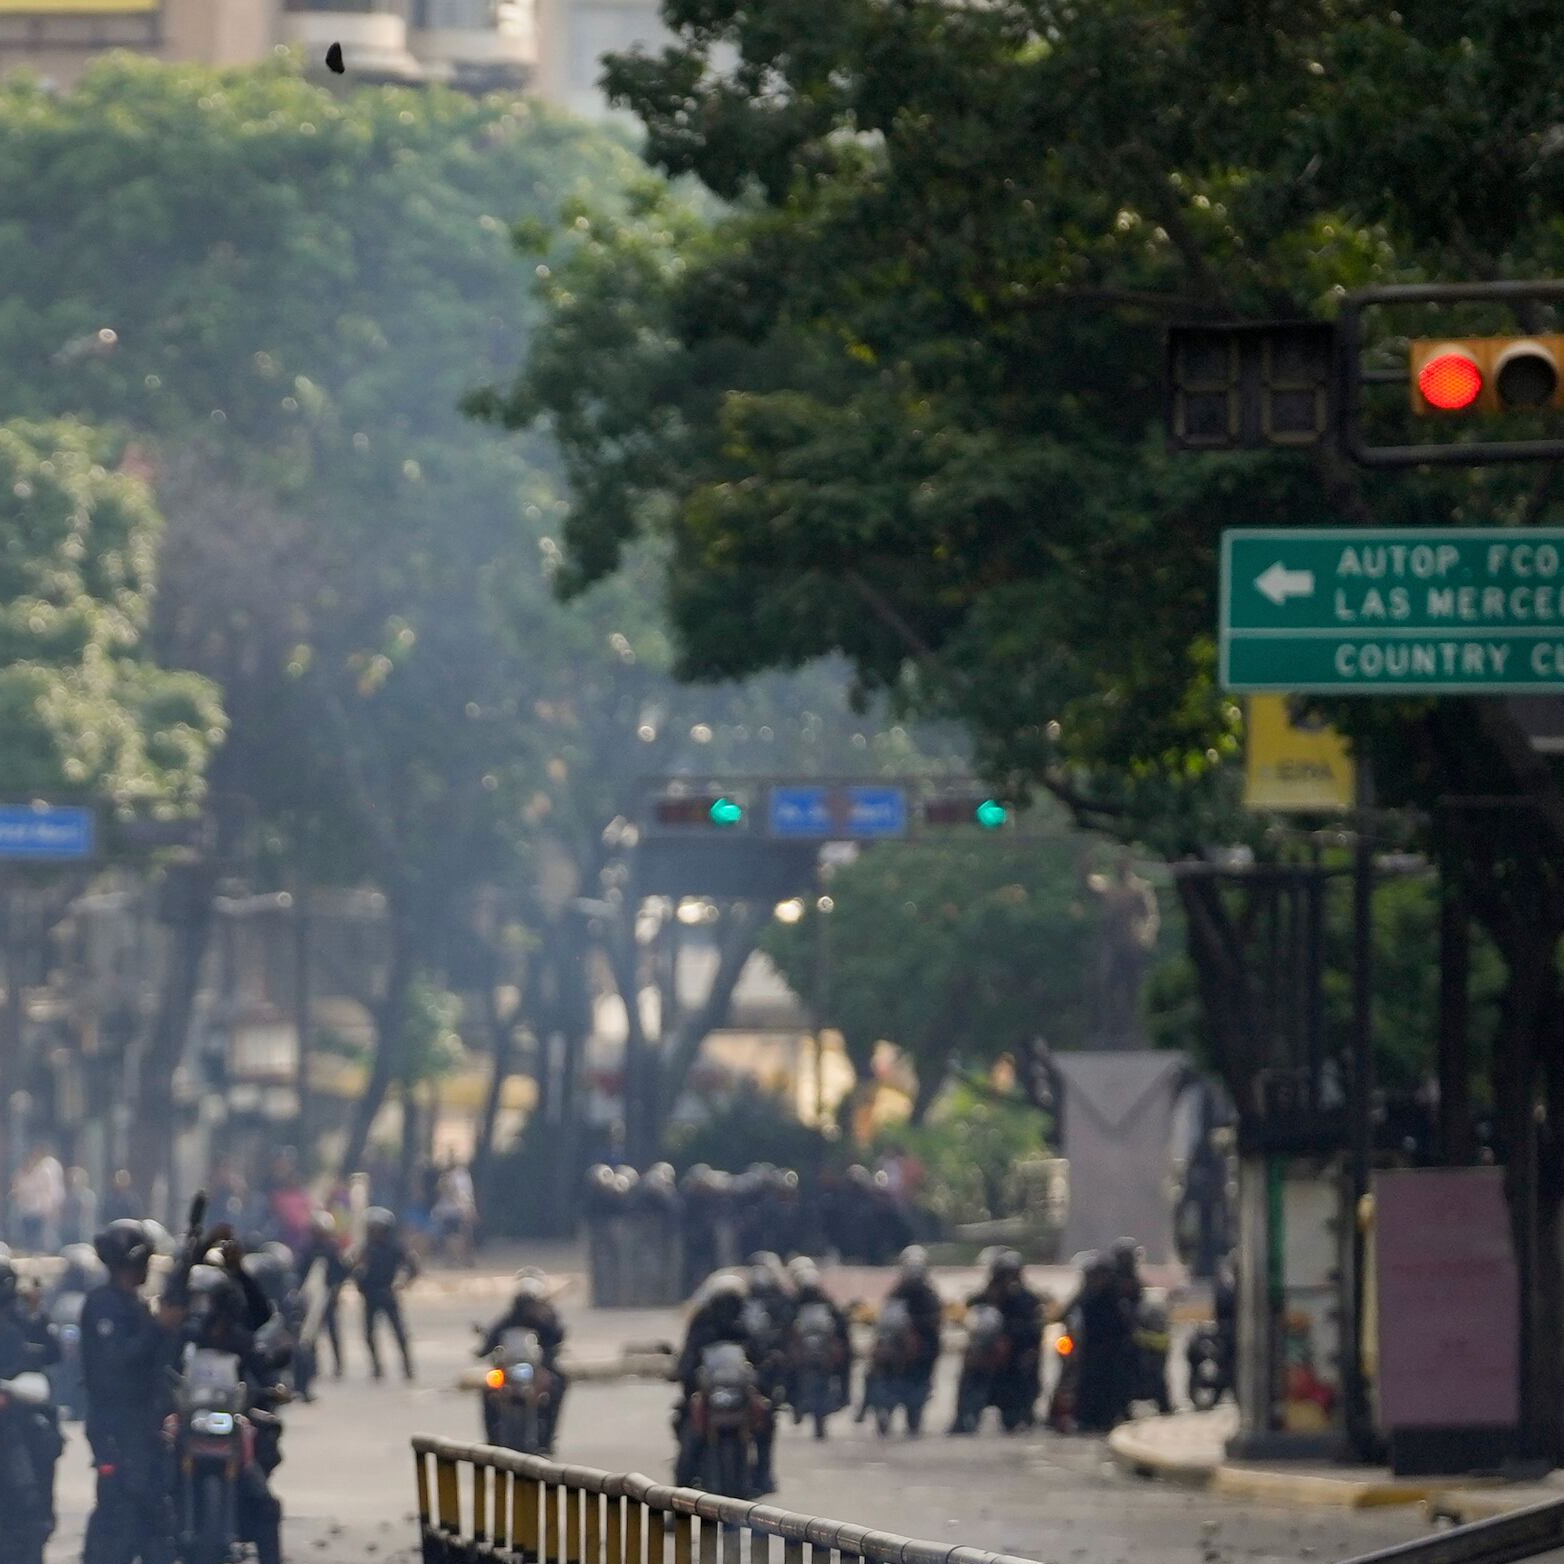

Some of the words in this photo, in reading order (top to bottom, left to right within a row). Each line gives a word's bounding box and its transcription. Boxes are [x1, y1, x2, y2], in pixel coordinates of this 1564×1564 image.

[1335, 586, 1411, 621] LAS
[1426, 586, 1564, 621] MERCE
[1334, 643, 1511, 677] COUNTRY
